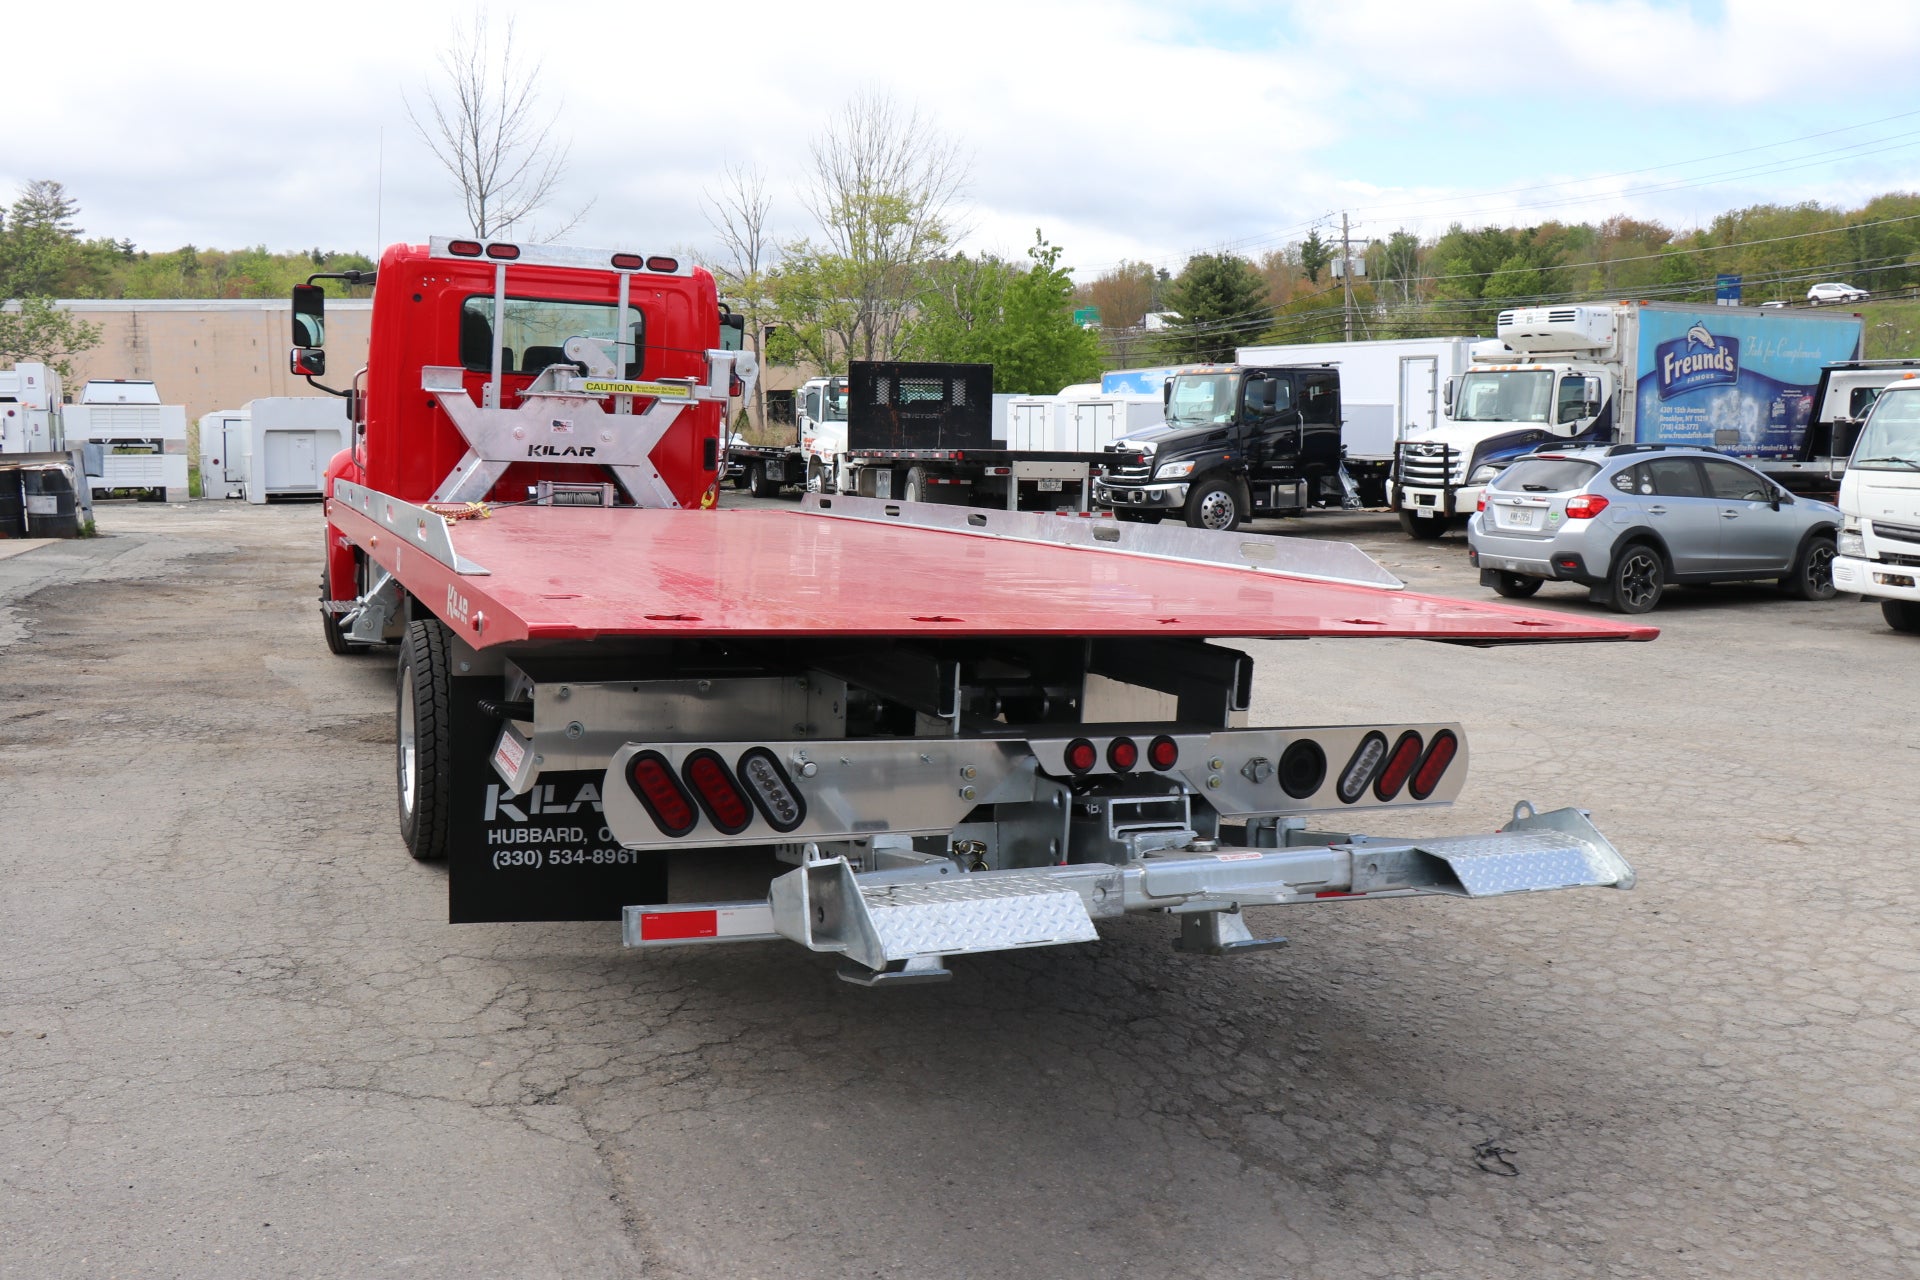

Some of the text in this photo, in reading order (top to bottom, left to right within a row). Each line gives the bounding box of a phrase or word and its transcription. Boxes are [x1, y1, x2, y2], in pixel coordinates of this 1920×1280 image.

[1664, 346, 1734, 385] Freund's
[586, 382, 633, 392] CAUTION
[1687, 373, 1715, 384] FAMOUS
[1660, 424, 1674, 432] (718)
[527, 444, 596, 457] KILAR
[446, 583, 468, 625] KILAR
[483, 783, 604, 822] KILA
[488, 826, 617, 845] HUBBARD, O
[492, 848, 638, 870] (330) 534-8961
